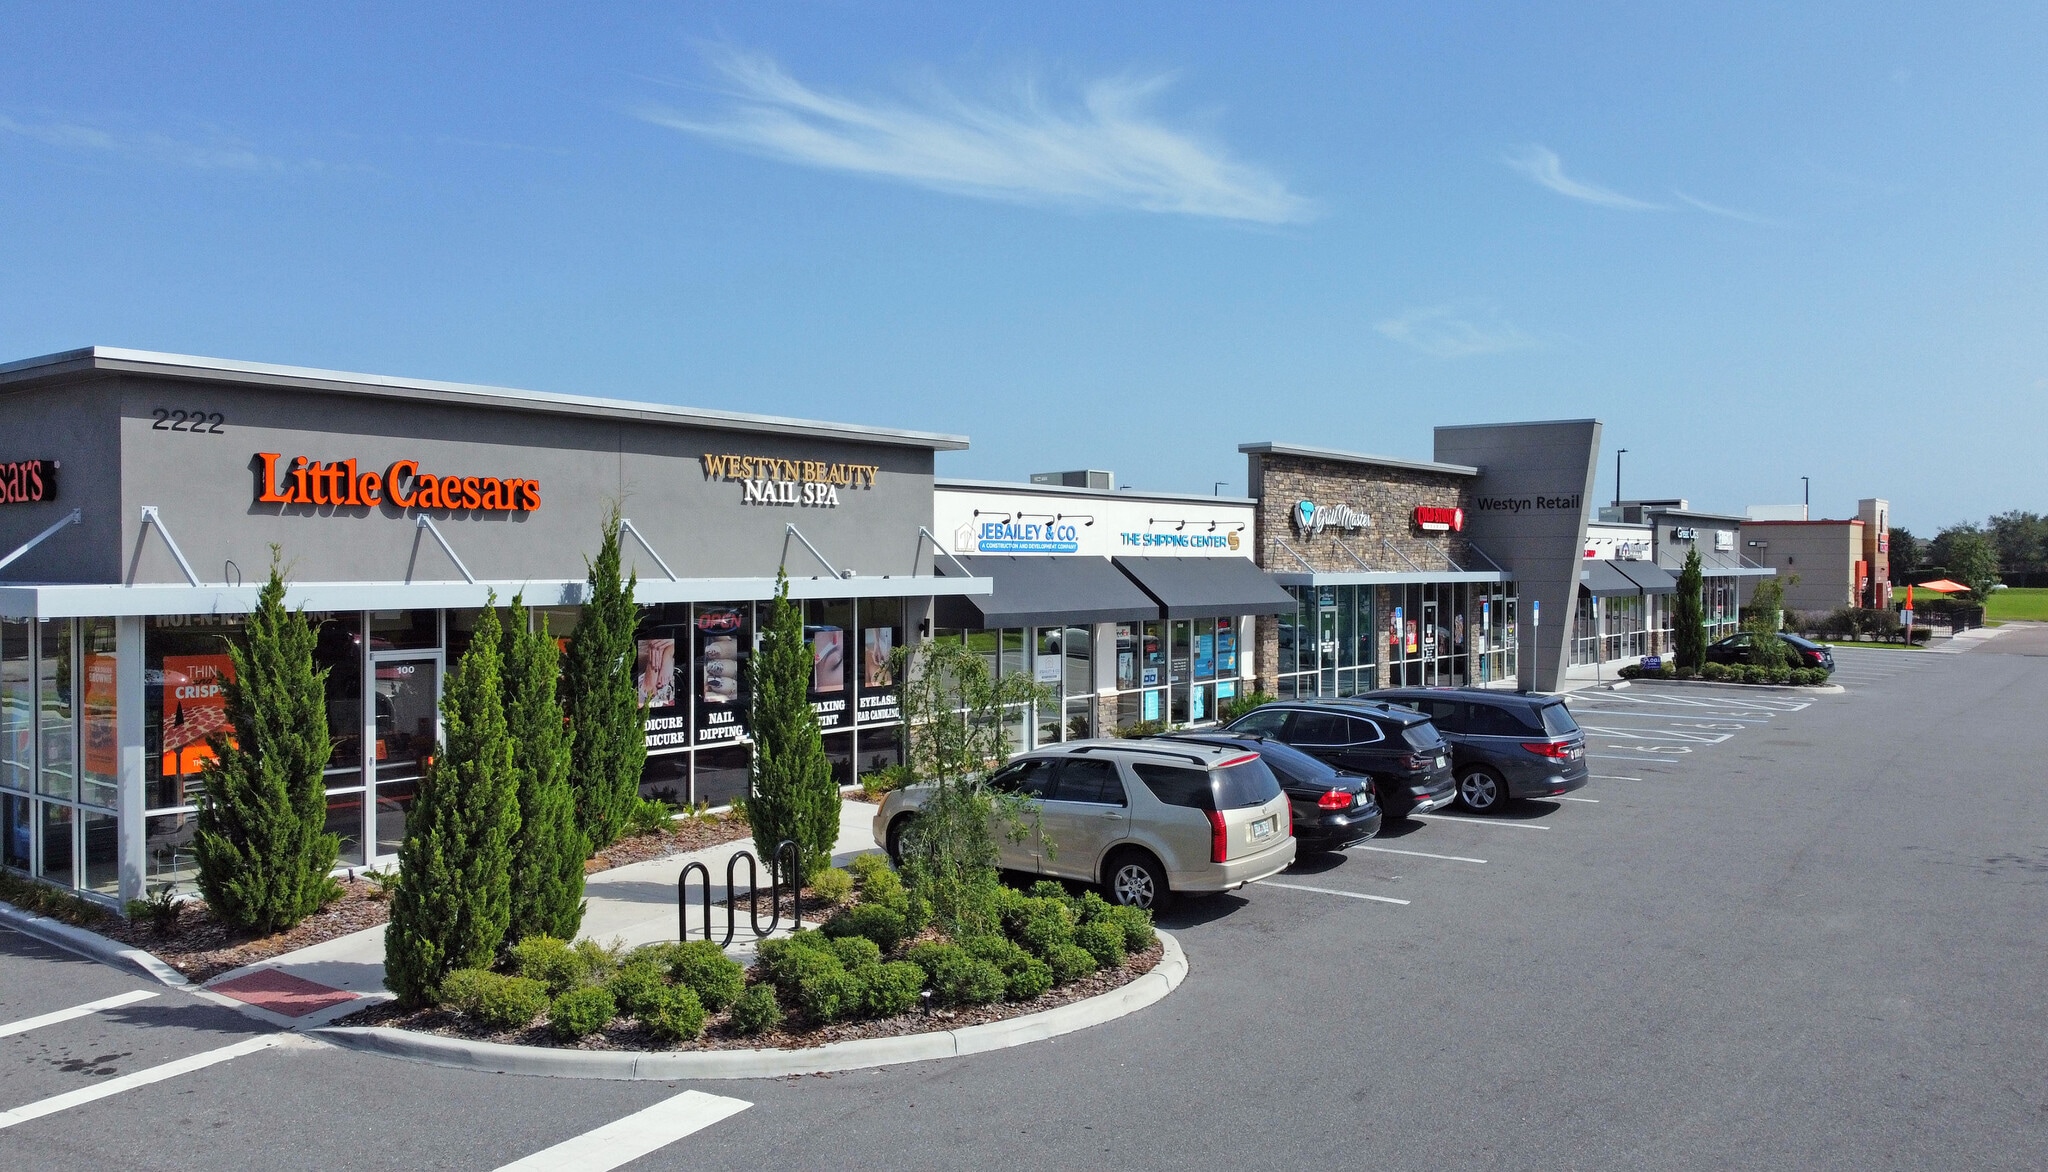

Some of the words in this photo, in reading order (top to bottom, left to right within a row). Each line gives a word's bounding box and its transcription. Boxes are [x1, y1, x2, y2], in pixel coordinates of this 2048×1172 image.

[152, 408, 225, 434] 2222
[704, 453, 801, 482] WESTYN
[803, 460, 879, 486] BEAUTY
[259, 452, 382, 507] Little
[387, 459, 541, 512] Caesars
[743, 479, 800, 503] NAIL
[803, 482, 840, 505] SPA
[1477, 498, 1532, 514] Westyn
[1536, 494, 1580, 509] Retail
[1316, 504, 1337, 533] Grill
[1337, 504, 1371, 530] Master
[977, 522, 1042, 540] JEBAILEY
[1045, 524, 1054, 541] &
[1120, 532, 1141, 547] THE
[1142, 533, 1189, 548] SHIPPING
[1190, 535, 1227, 548] CENTER
[156, 612, 249, 628] HOT-N-RE
[698, 613, 742, 629] OPEN
[187, 665, 217, 678] THIN
[397, 666, 415, 674] 100
[860, 695, 897, 708] EYELASH
[708, 711, 735, 724] NAIL
[817, 714, 839, 726] TINT
[857, 711, 870, 722] EAR
[870, 707, 900, 720] CANDLING
[645, 716, 683, 732] DICURE
[644, 731, 685, 747] NICURE
[699, 725, 743, 741] DIPPING
